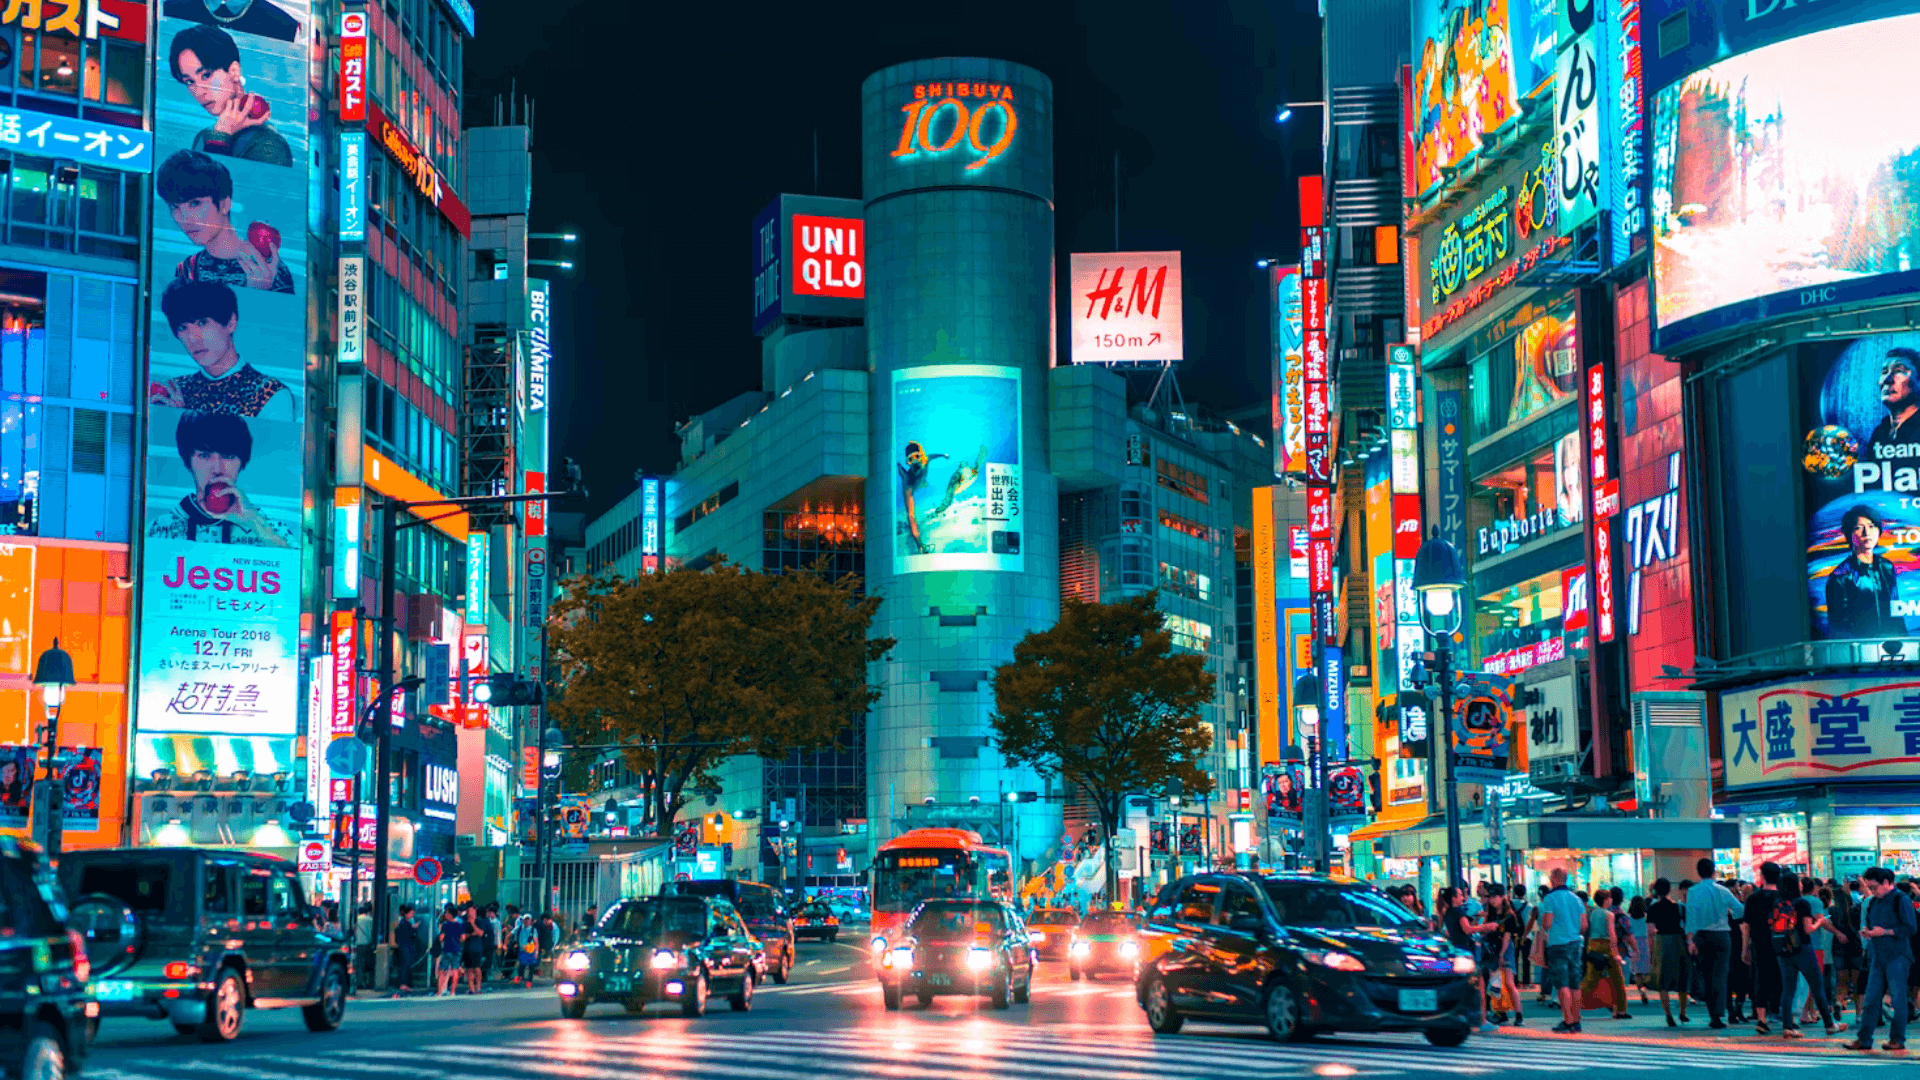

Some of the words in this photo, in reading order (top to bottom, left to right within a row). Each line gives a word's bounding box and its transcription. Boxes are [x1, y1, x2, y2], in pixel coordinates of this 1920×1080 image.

[344, 58, 362, 110] ガスト
[914, 83, 1014, 99] SHIBUYA
[890, 98, 1017, 169] 109
[760, 218, 775, 268] THE
[802, 225, 856, 257] UNI
[802, 258, 862, 291] QLO
[1085, 265, 1168, 320] H&M
[344, 262, 358, 353] 渋谷駅前ビル
[530, 290, 545, 323] BIC
[1800, 288, 1836, 306] DHC
[530, 327, 553, 412] CAMERA
[991, 475, 1019, 487] 世界に
[1854, 460, 1920, 493] Pla
[1441, 438, 1463, 558] サマーフルー
[1396, 519, 1419, 533] JTB
[1478, 508, 1554, 554] Euphoria
[162, 555, 281, 594] Jesus
[253, 559, 281, 567] SINGLE
[528, 548, 545, 578] OS
[1564, 572, 1587, 622] JT
[170, 626, 207, 637] Arena
[211, 628, 238, 639] Tour
[241, 630, 271, 641] 2018
[193, 641, 231, 657] 12.7
[234, 648, 253, 658] FRI
[159, 658, 280, 674] さいたまスーパーアリーナ
[336, 645, 352, 725] サンドラッグ
[1327, 659, 1339, 710] MIZUHO
[425, 763, 459, 806] LUSH
